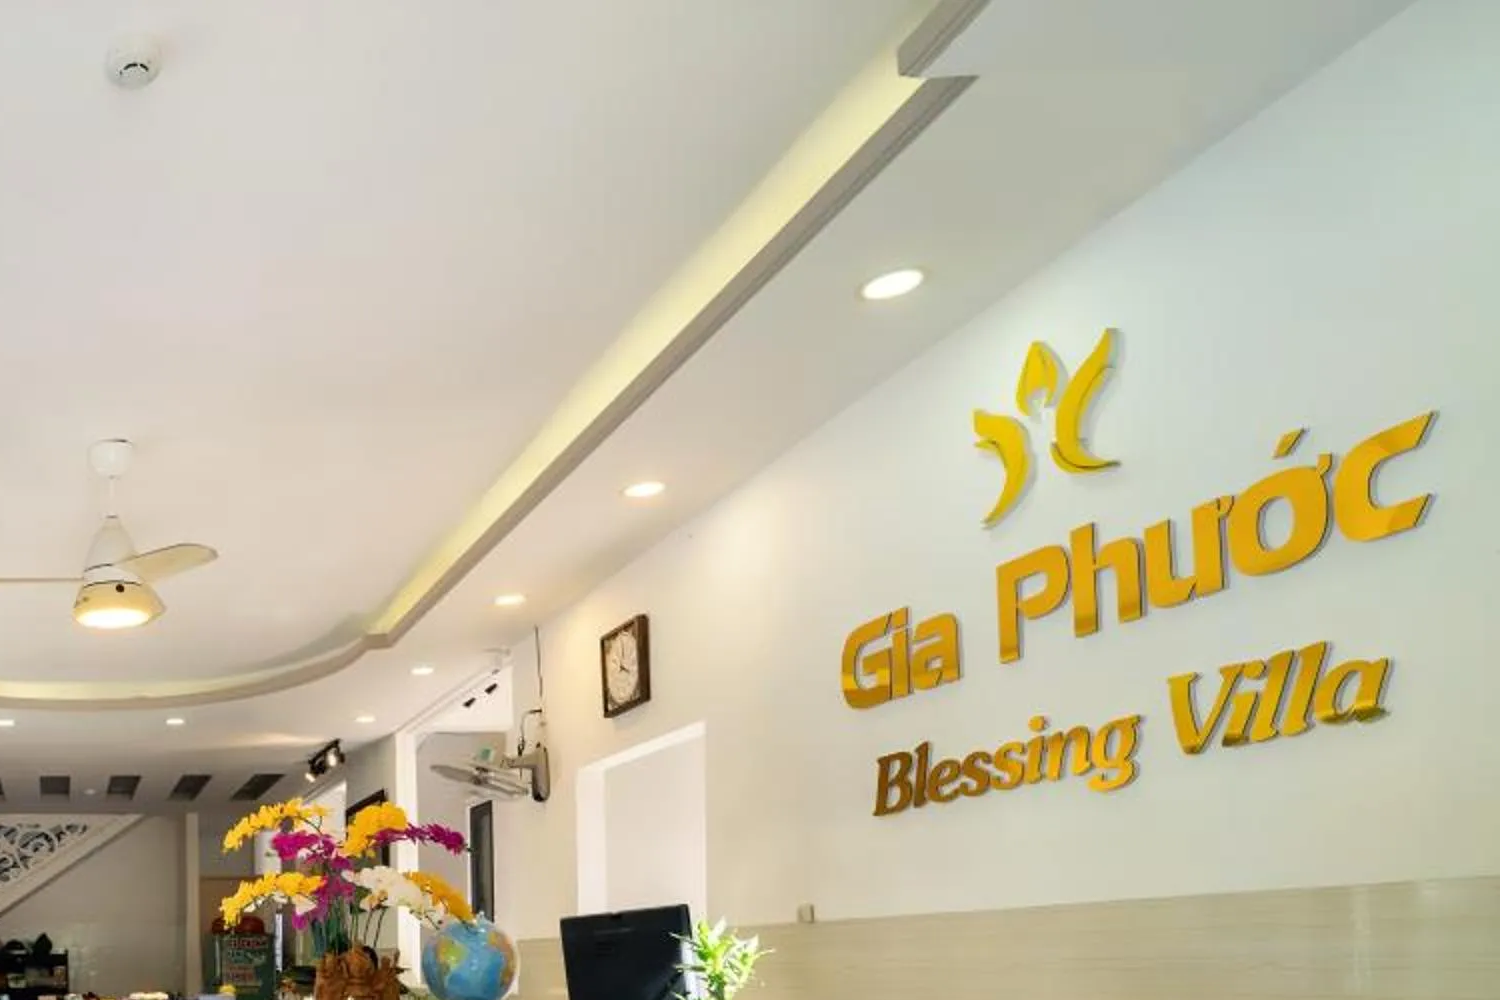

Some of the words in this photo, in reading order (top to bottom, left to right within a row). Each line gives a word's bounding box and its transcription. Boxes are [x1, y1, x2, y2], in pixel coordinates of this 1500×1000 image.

[840, 606, 963, 710] Gia
[996, 410, 1437, 665] Phước
[873, 714, 1144, 817] Blessing
[1167, 641, 1392, 755] Villa
